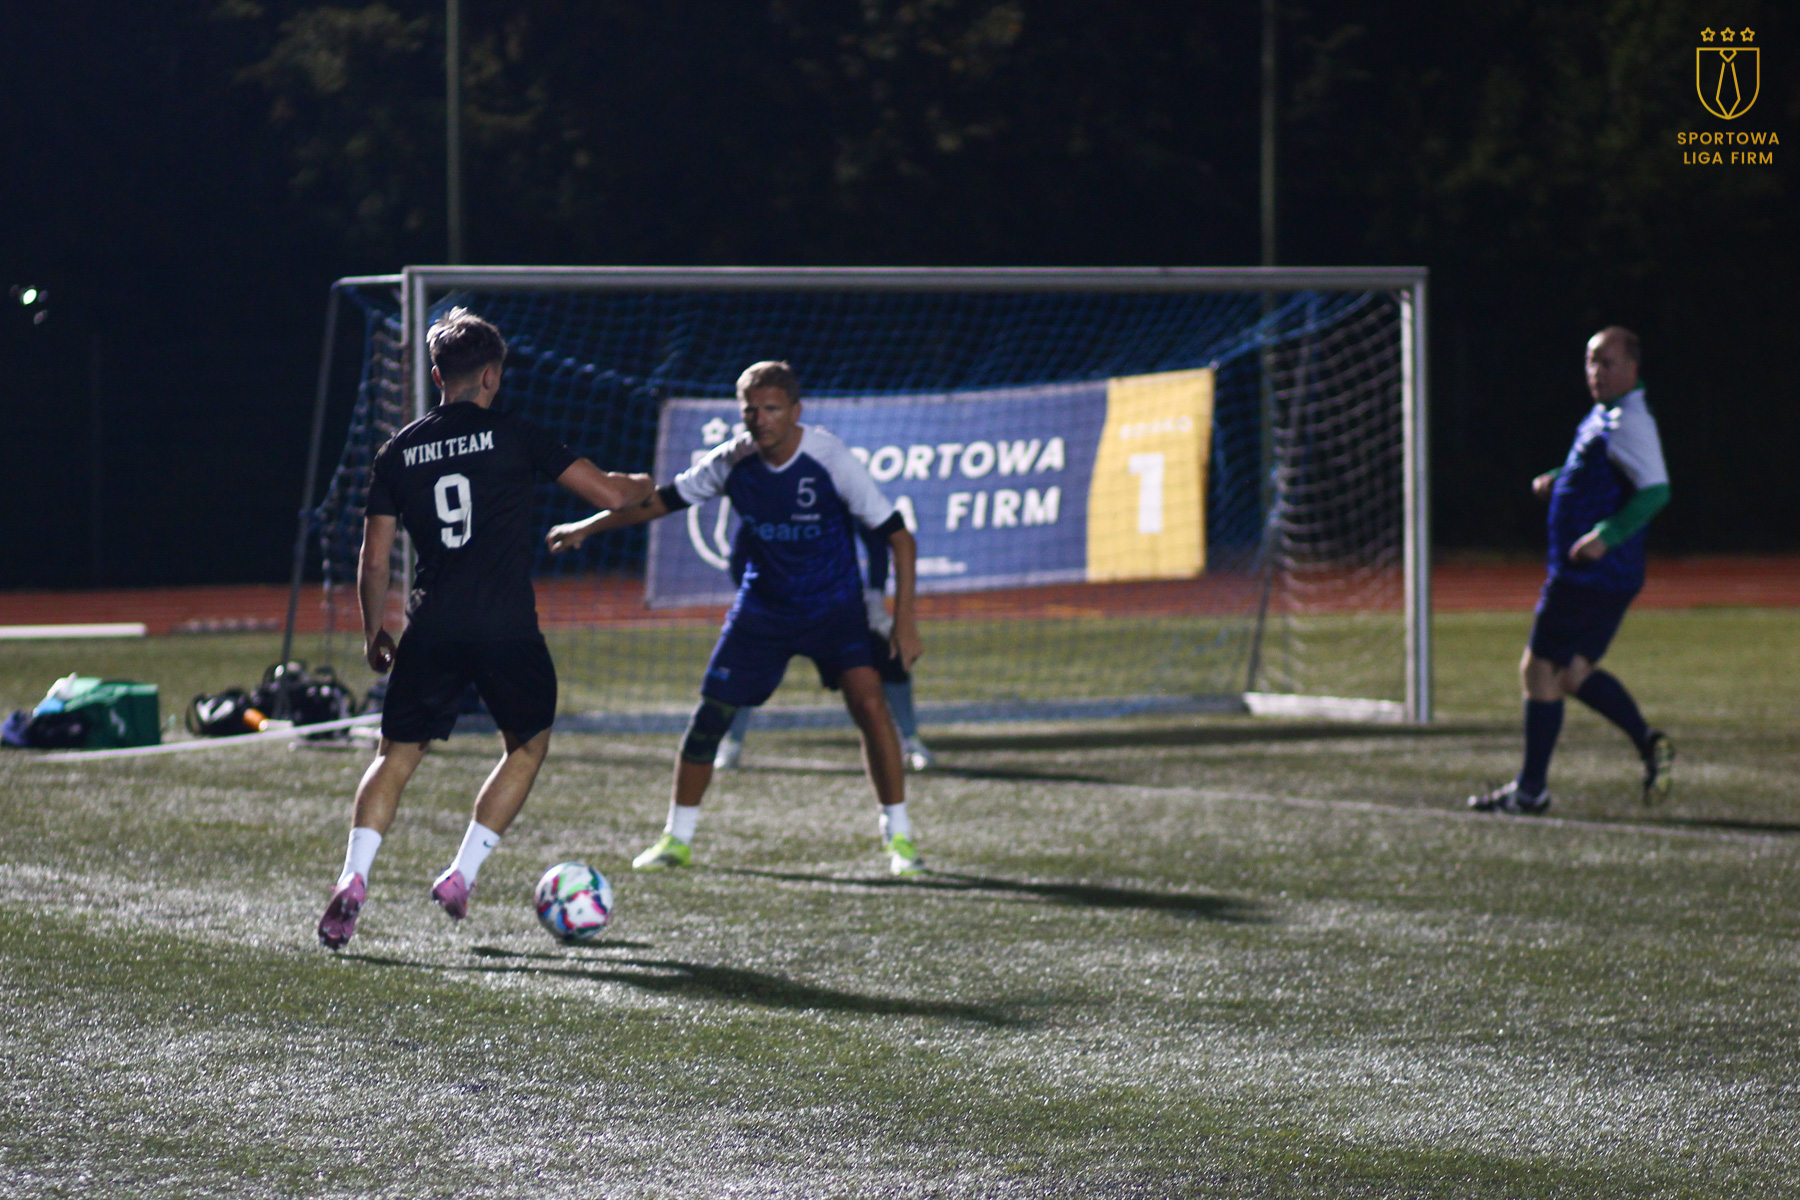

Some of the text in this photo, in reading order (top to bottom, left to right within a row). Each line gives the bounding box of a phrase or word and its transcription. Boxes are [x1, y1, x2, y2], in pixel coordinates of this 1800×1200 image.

[402, 430, 495, 467] WINI TEAM
[433, 472, 473, 549] 9
[795, 477, 817, 508] 5
[945, 486, 1061, 531] FIRM
[1127, 452, 1165, 534] 1
